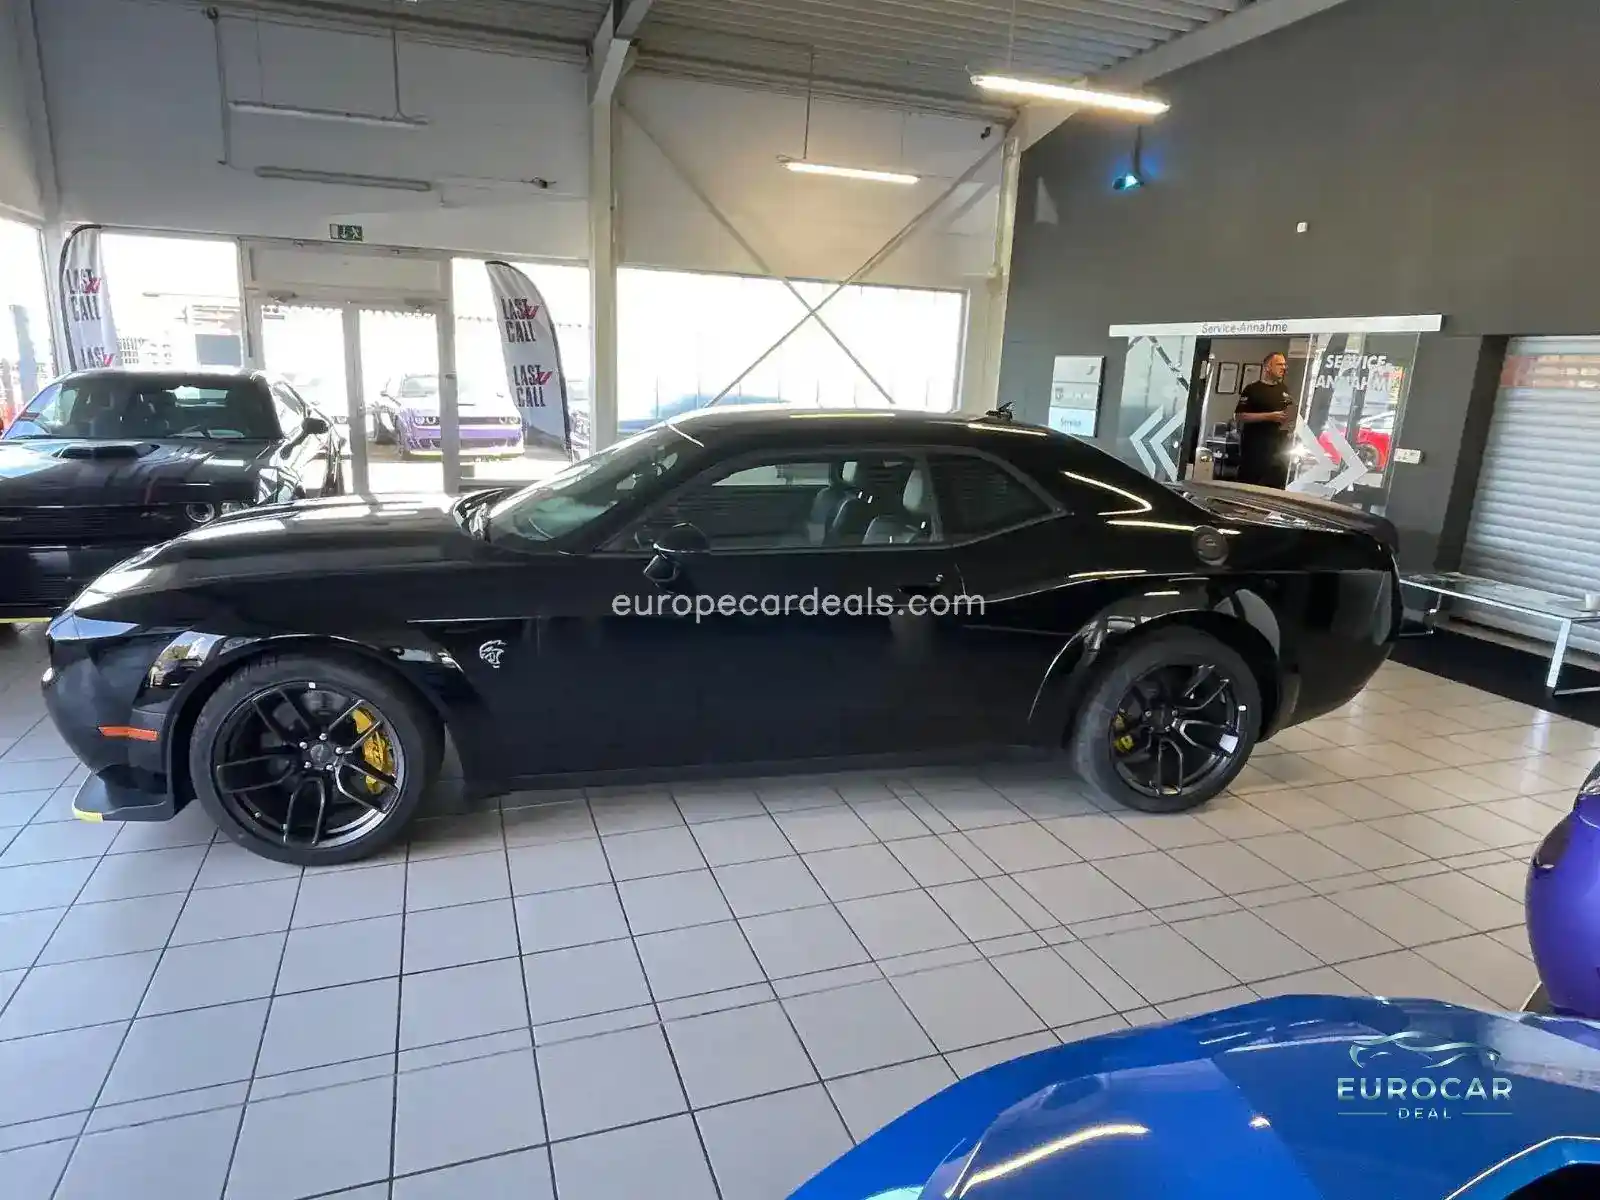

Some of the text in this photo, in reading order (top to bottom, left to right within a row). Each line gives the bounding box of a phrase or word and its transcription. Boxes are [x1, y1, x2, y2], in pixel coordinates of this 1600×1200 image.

[66, 268, 98, 294] LAST
[70, 295, 101, 321] CALL
[500, 298, 531, 320] LAST
[505, 320, 536, 342] CALL
[1201, 322, 1288, 334] Service-Annahme
[81, 346, 109, 369] LAST
[513, 364, 545, 386] LAST
[516, 386, 546, 407] CALL
